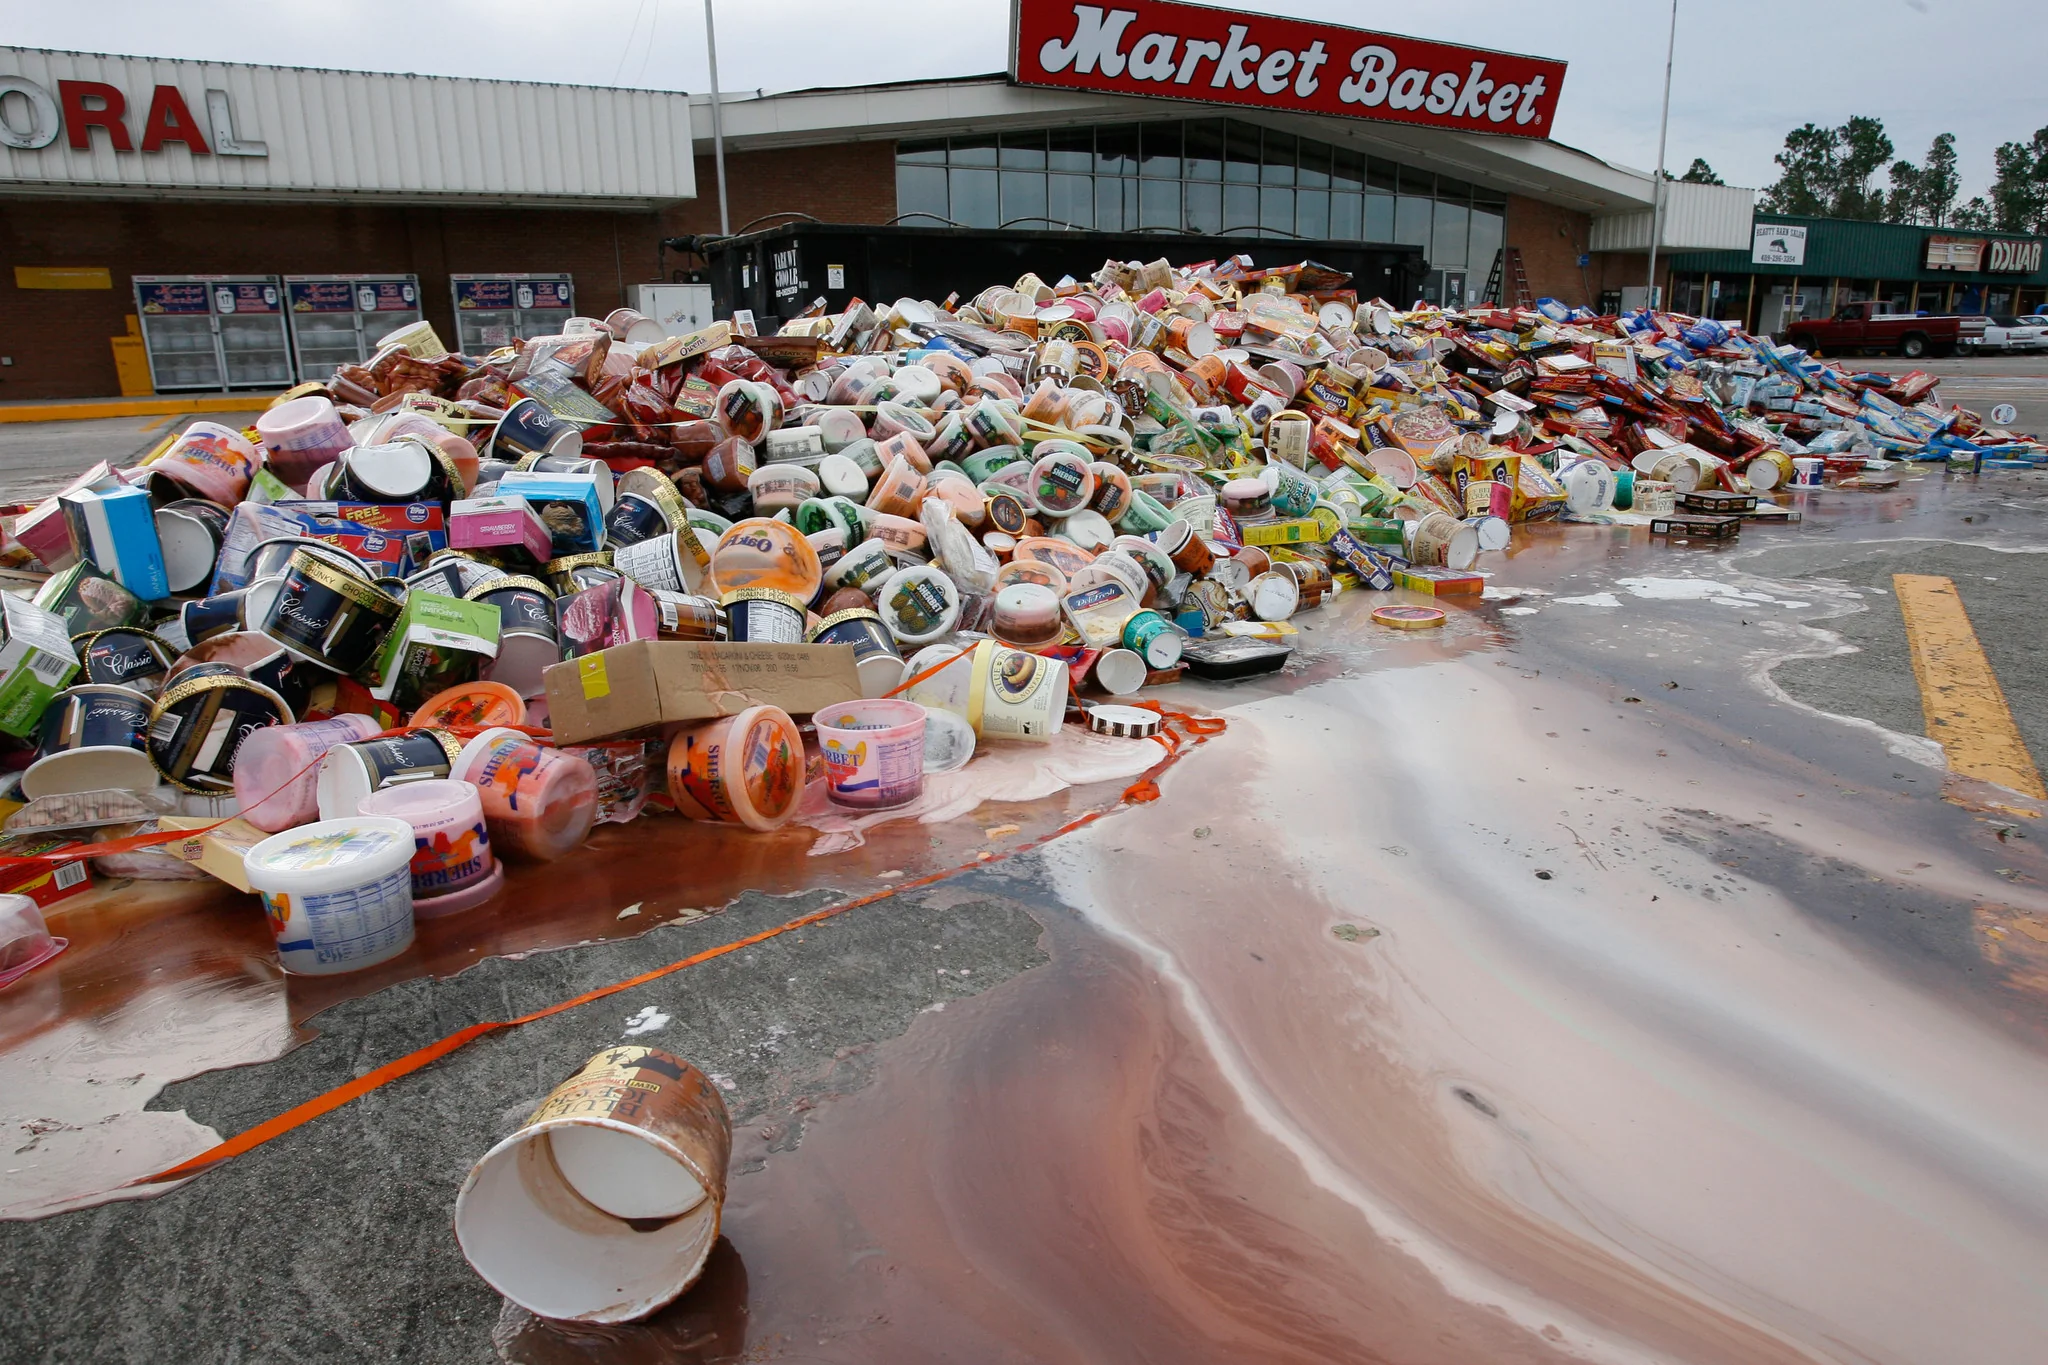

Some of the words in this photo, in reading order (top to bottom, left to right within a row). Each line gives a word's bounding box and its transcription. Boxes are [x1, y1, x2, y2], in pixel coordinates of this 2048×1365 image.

[1039, 5, 1328, 97] Market
[1339, 45, 1547, 125] Basket
[1756, 227, 1775, 237] BEAUTY
[1776, 227, 1789, 236] BARN
[1790, 228, 1805, 239] SALON
[1989, 240, 2042, 272] DOLLAR
[679, 335, 708, 357] Owens
[728, 393, 748, 419] SHERBET
[1051, 467, 1082, 485] SHERBET
[1097, 484, 1118, 512] SHERBET
[345, 505, 381, 522] FREE
[479, 523, 516, 534] STRAWBERRY
[304, 563, 336, 586] CHUNKY
[278, 592, 330, 629] Classic
[916, 583, 943, 615] SHERBET
[103, 652, 152, 675] Classic
[750, 652, 774, 661] CHEESE
[992, 667, 1005, 694] BLUE
[706, 744, 731, 818] SHERBET
[598, 1085, 647, 1104] ICE
[628, 1080, 659, 1092] NEW!
[550, 1099, 640, 1119] BLUE
